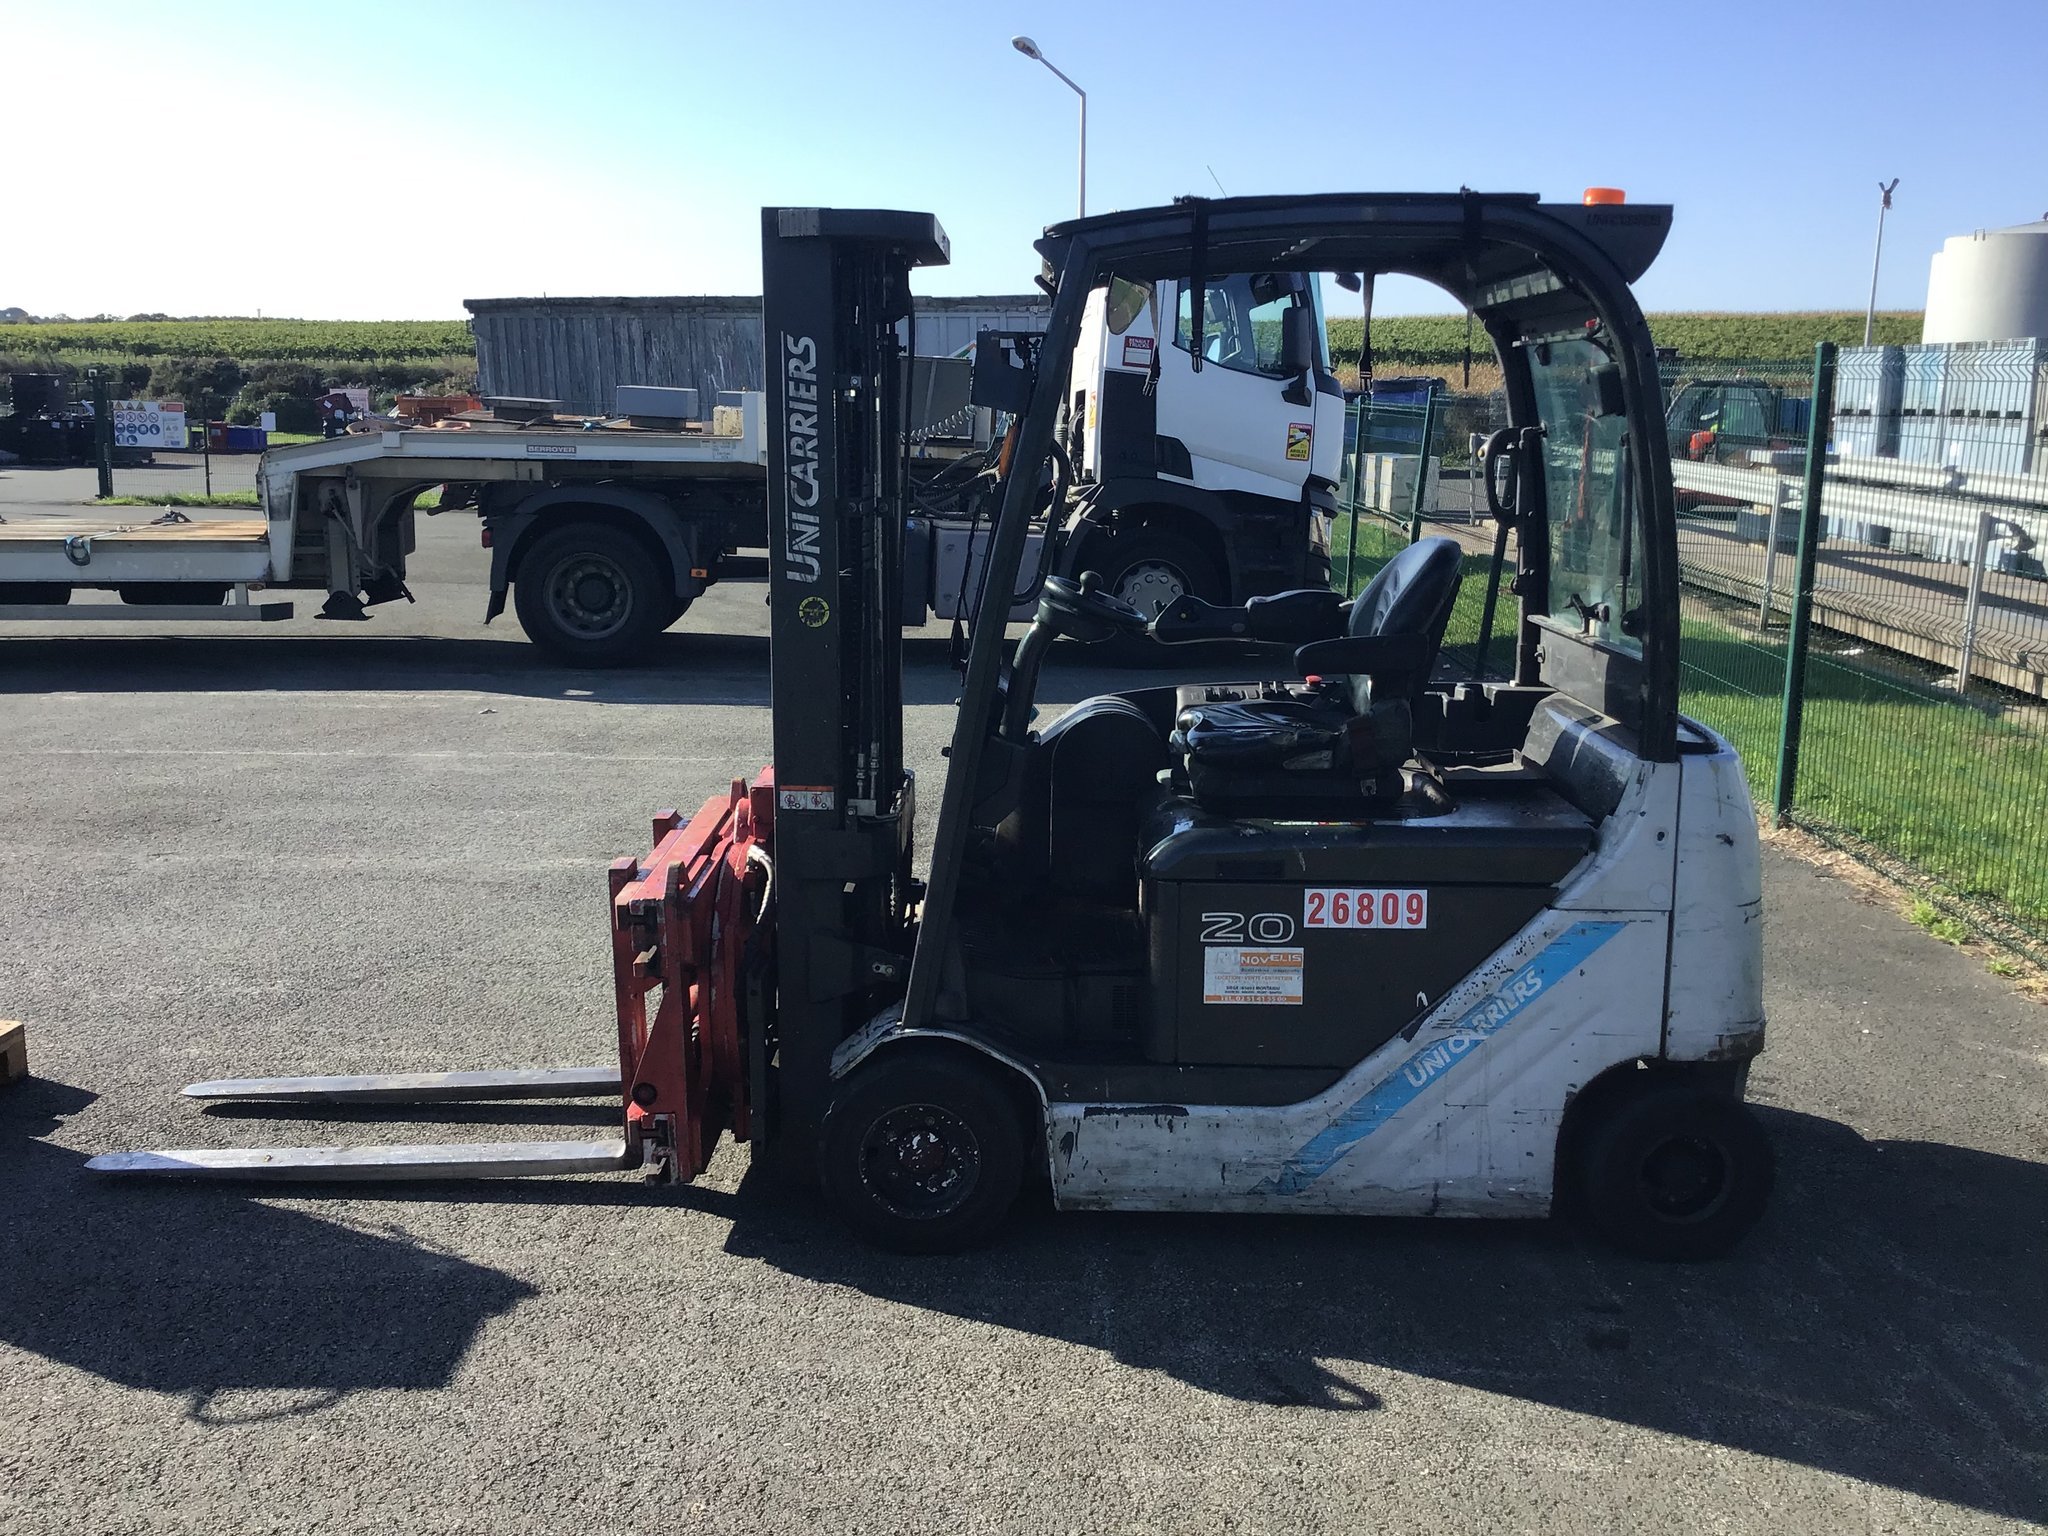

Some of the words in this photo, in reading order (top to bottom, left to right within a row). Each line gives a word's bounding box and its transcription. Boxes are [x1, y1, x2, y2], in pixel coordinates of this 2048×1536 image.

[1307, 892, 1424, 925] 26809
[1200, 912, 1295, 944] 20
[1241, 954, 1302, 965] NOVELIS
